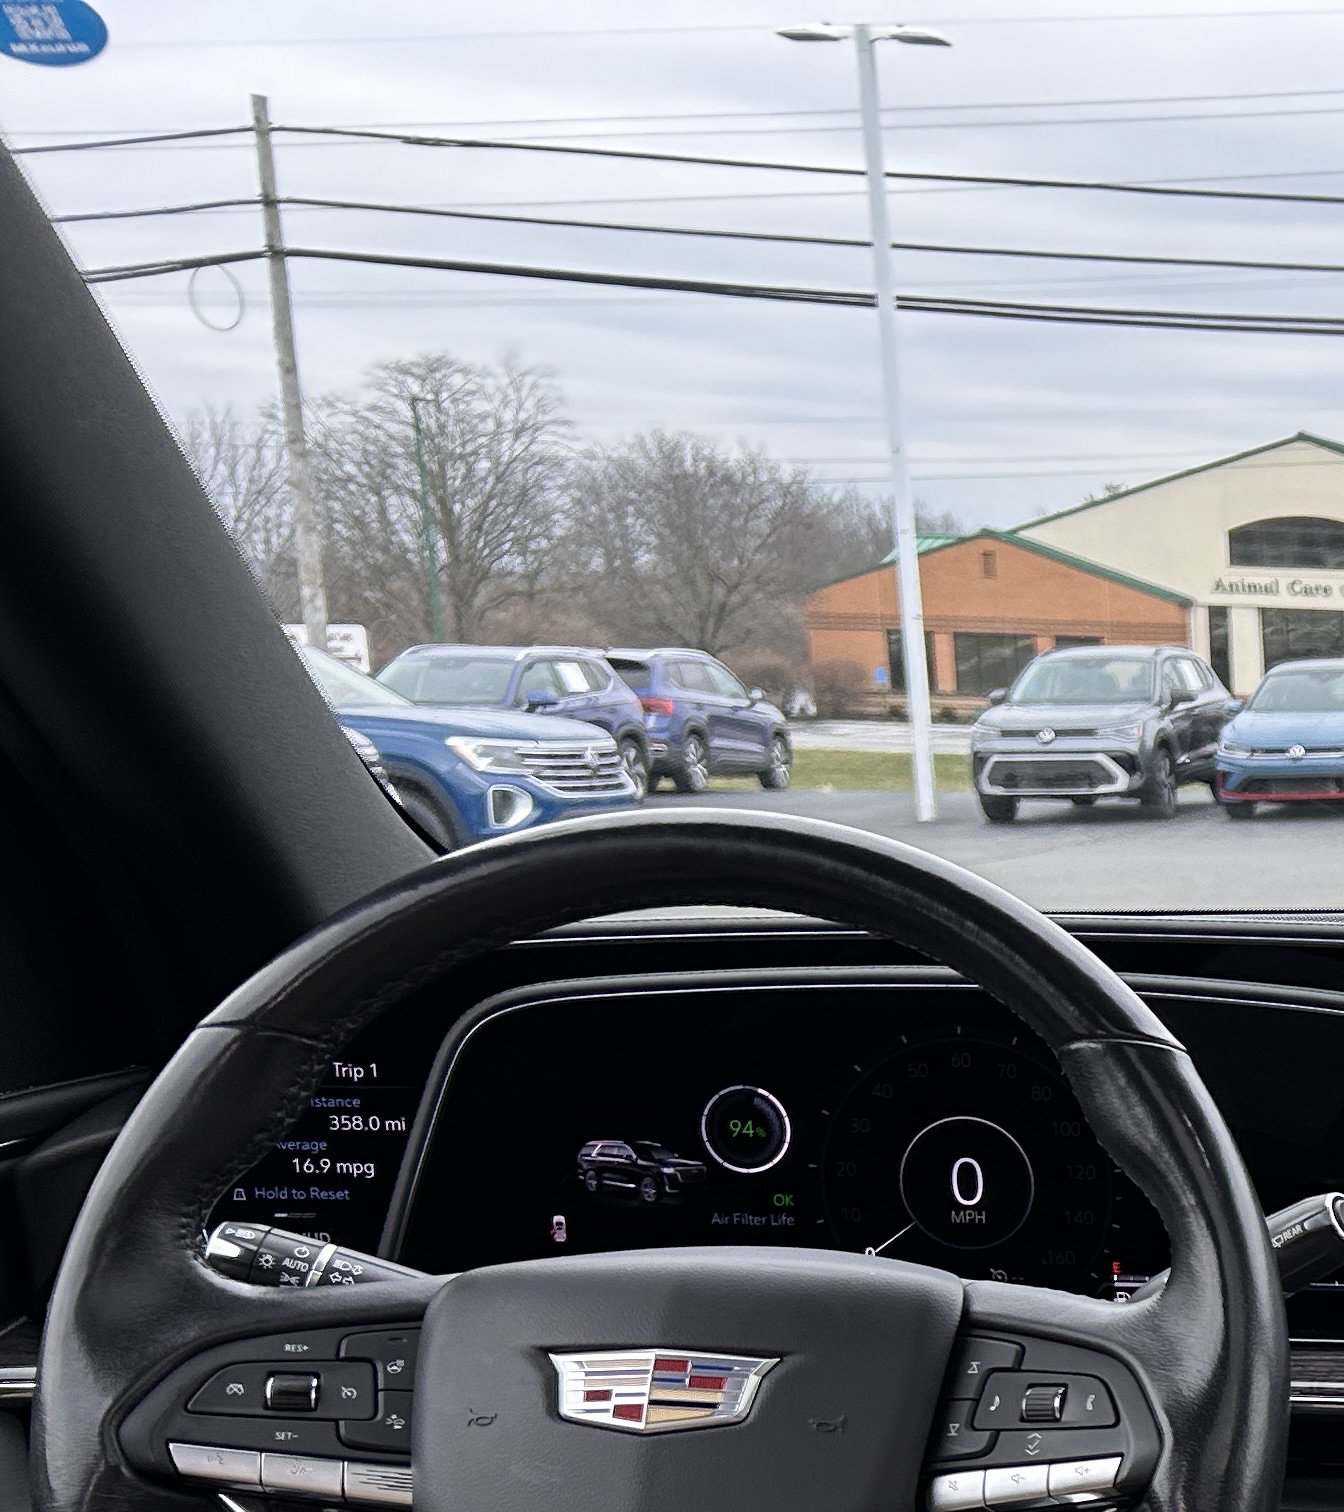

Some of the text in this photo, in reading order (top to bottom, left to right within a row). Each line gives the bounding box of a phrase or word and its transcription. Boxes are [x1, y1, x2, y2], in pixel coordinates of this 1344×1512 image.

[1213, 577, 1280, 596] Animal
[1287, 579, 1334, 598] Care
[951, 1052, 972, 1068] 60
[332, 1061, 378, 1082] Trip 1
[906, 1062, 929, 1079] 50
[999, 1064, 1017, 1080] 70
[870, 1083, 893, 1099] 40
[1031, 1084, 1051, 1101] 80
[310, 1096, 361, 1109] istance
[328, 1115, 406, 1132] 358.0 mi
[849, 1117, 871, 1134] 30
[291, 1158, 375, 1179] 16.9 mpg
[835, 1160, 857, 1177] 20
[1066, 1164, 1097, 1181] 120
[951, 1156, 984, 1206] 0
[254, 1187, 351, 1201] Hold to Reset
[773, 1193, 796, 1207] OK
[711, 1212, 796, 1226] Air Filter Life
[950, 1210, 986, 1224] MPH
[1064, 1210, 1095, 1225] 140
[1282, 1224, 1303, 1241] REAR
[281, 1257, 309, 1272] AUTO
[1112, 1261, 1120, 1273] E
